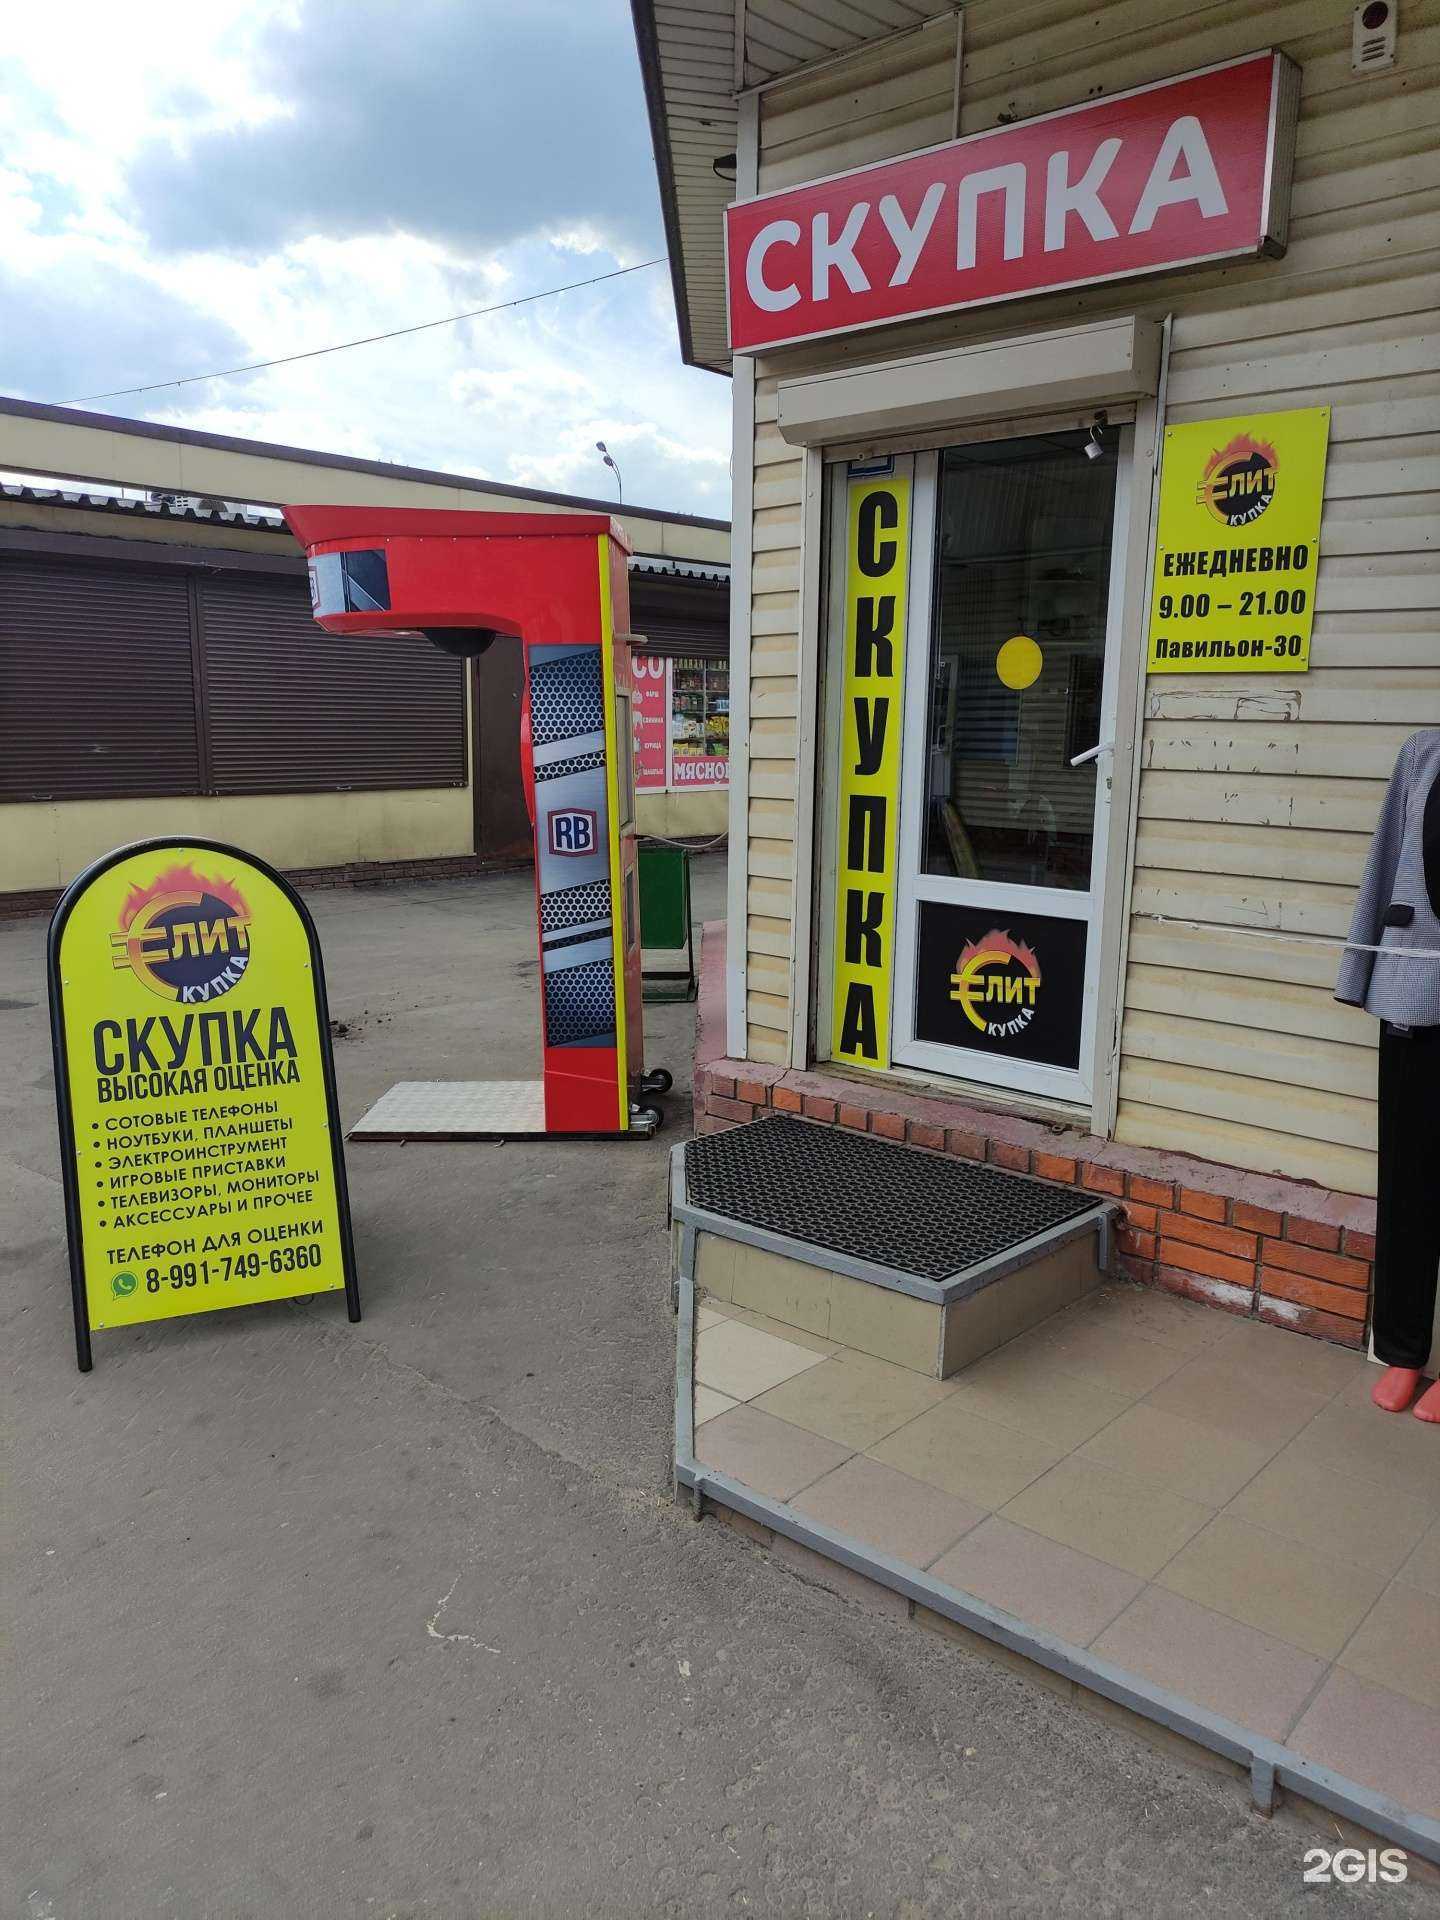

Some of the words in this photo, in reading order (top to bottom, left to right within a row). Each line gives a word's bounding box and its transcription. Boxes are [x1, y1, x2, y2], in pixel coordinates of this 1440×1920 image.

[746, 115, 1229, 312] СКУПКА
[1163, 544, 1309, 578] ЕЖЕДНЕВНО
[1159, 593, 1211, 618] 9.00
[1239, 589, 1306, 616] 21.00
[1155, 635, 1302, 659] Павильон-30
[839, 490, 899, 1062] СКУПКА
[555, 815, 591, 850] RB
[93, 1006, 298, 1076] СКУПКА
[97, 1070, 208, 1104] ВЫСОКАЯ
[214, 1060, 301, 1092] ОЦЕНКА
[105, 1110, 188, 1132] СОТОВЫЕ
[192, 1100, 279, 1122] ТЕЛЕФОНЫ
[107, 1128, 199, 1150] НОУТБУКИ,
[204, 1117, 293, 1139] ПЛАНШЕТЫ
[108, 1136, 288, 1170] ЭЛЕКТРОИНСТРУМЕНТ
[110, 1168, 187, 1189] ИГРОВЫЕ
[192, 1156, 286, 1179] ПРИСТАВКИ
[111, 1184, 222, 1209] ТЕЛЕВИЗОРЫ,
[227, 1170, 320, 1194] МОНИТОРЫ
[113, 1202, 232, 1228] АКСЕССУАРЫ
[237, 1200, 248, 1211] И
[253, 1190, 313, 1209] ПРОЧЕЕ
[107, 1239, 196, 1264] ТЕЛЕФОН
[201, 1232, 241, 1253] ДЛЯ
[247, 1220, 324, 1243] ОЦЕНКИ
[146, 1243, 322, 1293] 8-991-749-6360
